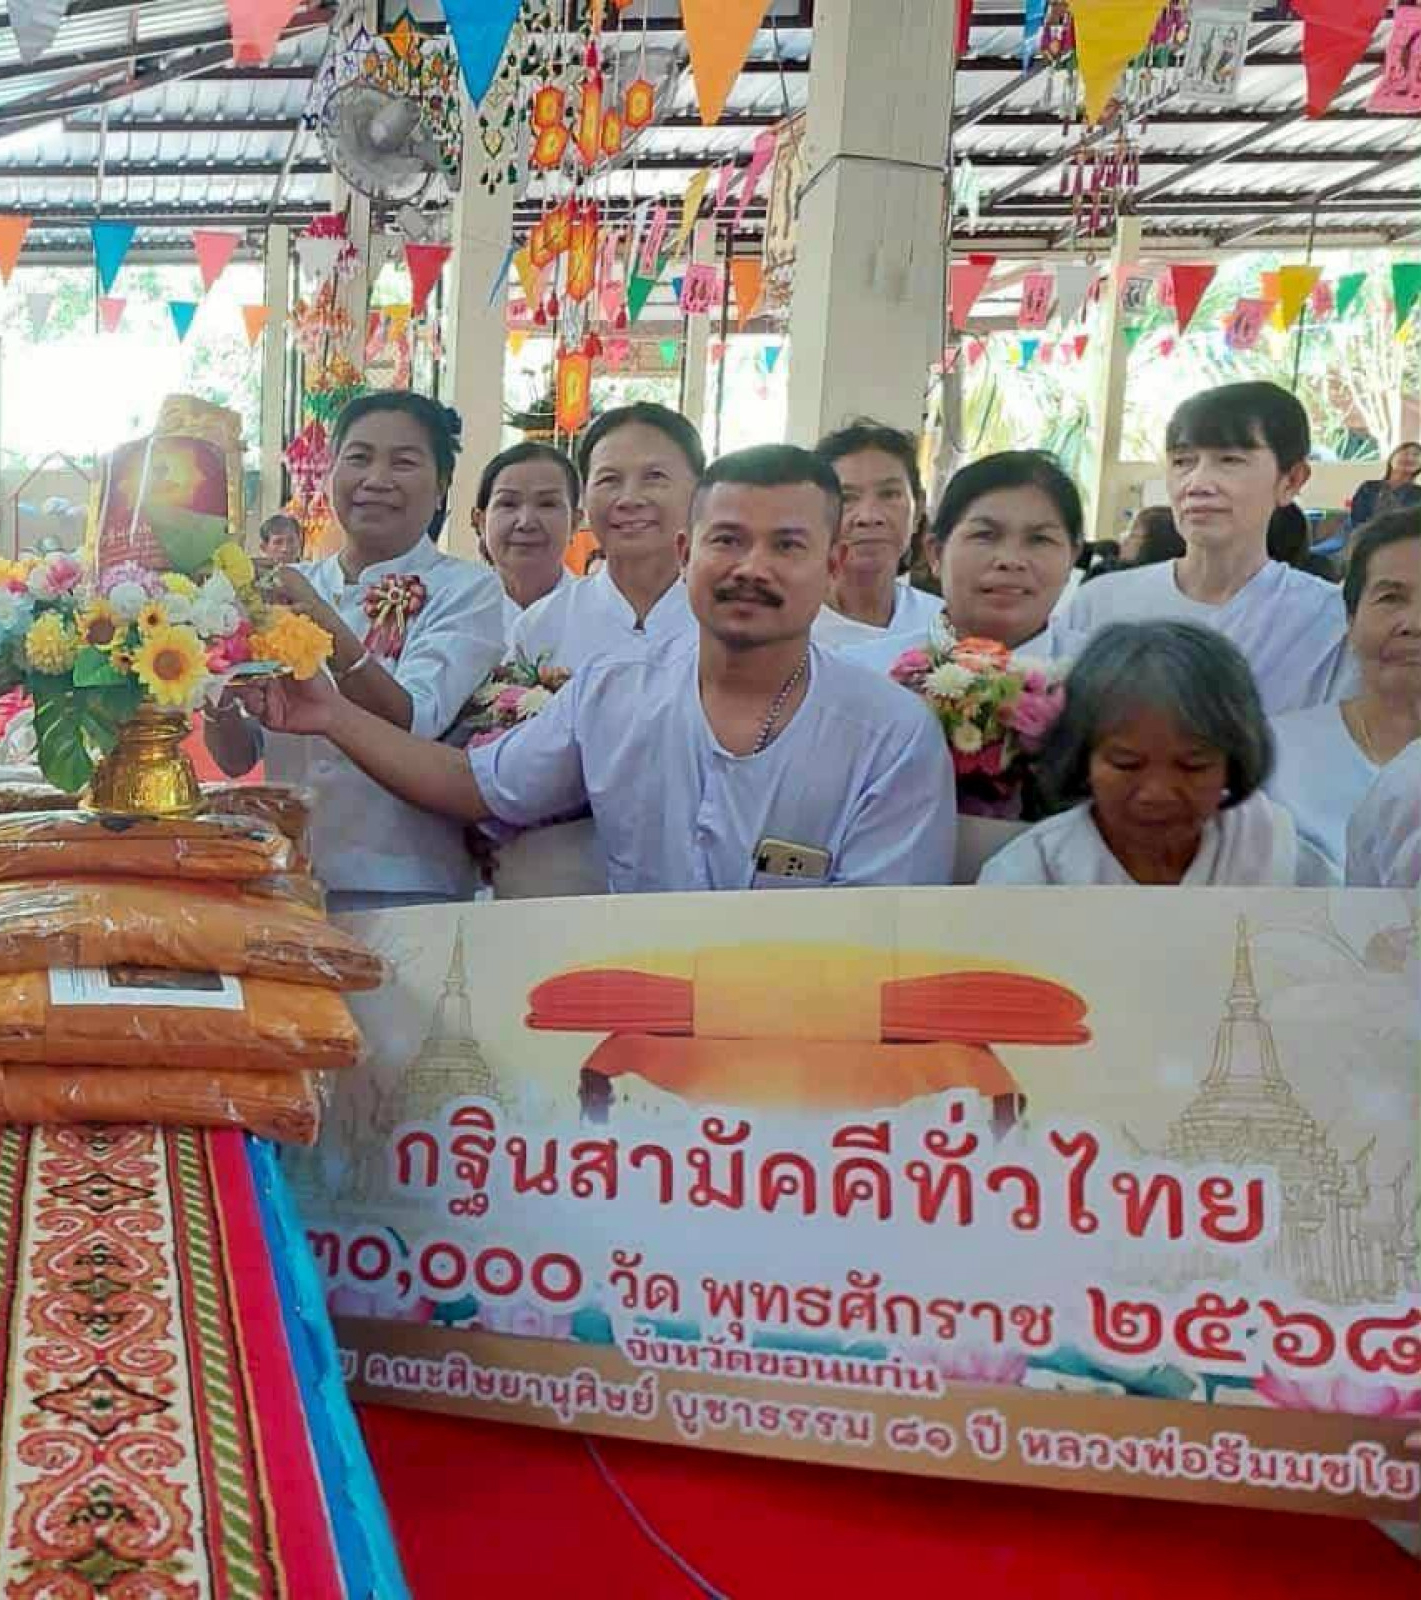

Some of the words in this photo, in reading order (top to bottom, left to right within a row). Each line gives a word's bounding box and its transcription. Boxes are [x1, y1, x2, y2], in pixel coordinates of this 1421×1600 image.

[395, 1101, 1266, 1244] กฐินสามัคคีทั่วไทย
[609, 1250, 680, 1314] วัด
[701, 1270, 1054, 1346] พุทธศักราช
[1087, 1287, 1421, 1375] ๒๕๖๘
[626, 1327, 940, 1394] จังหวัดขอนแก่น
[367, 1352, 657, 1419] คณะศิษยานุศิษย์
[674, 1389, 871, 1441] บูชาธรรม
[891, 1421, 954, 1454] ๘๑
[971, 1414, 1004, 1455] ปี
